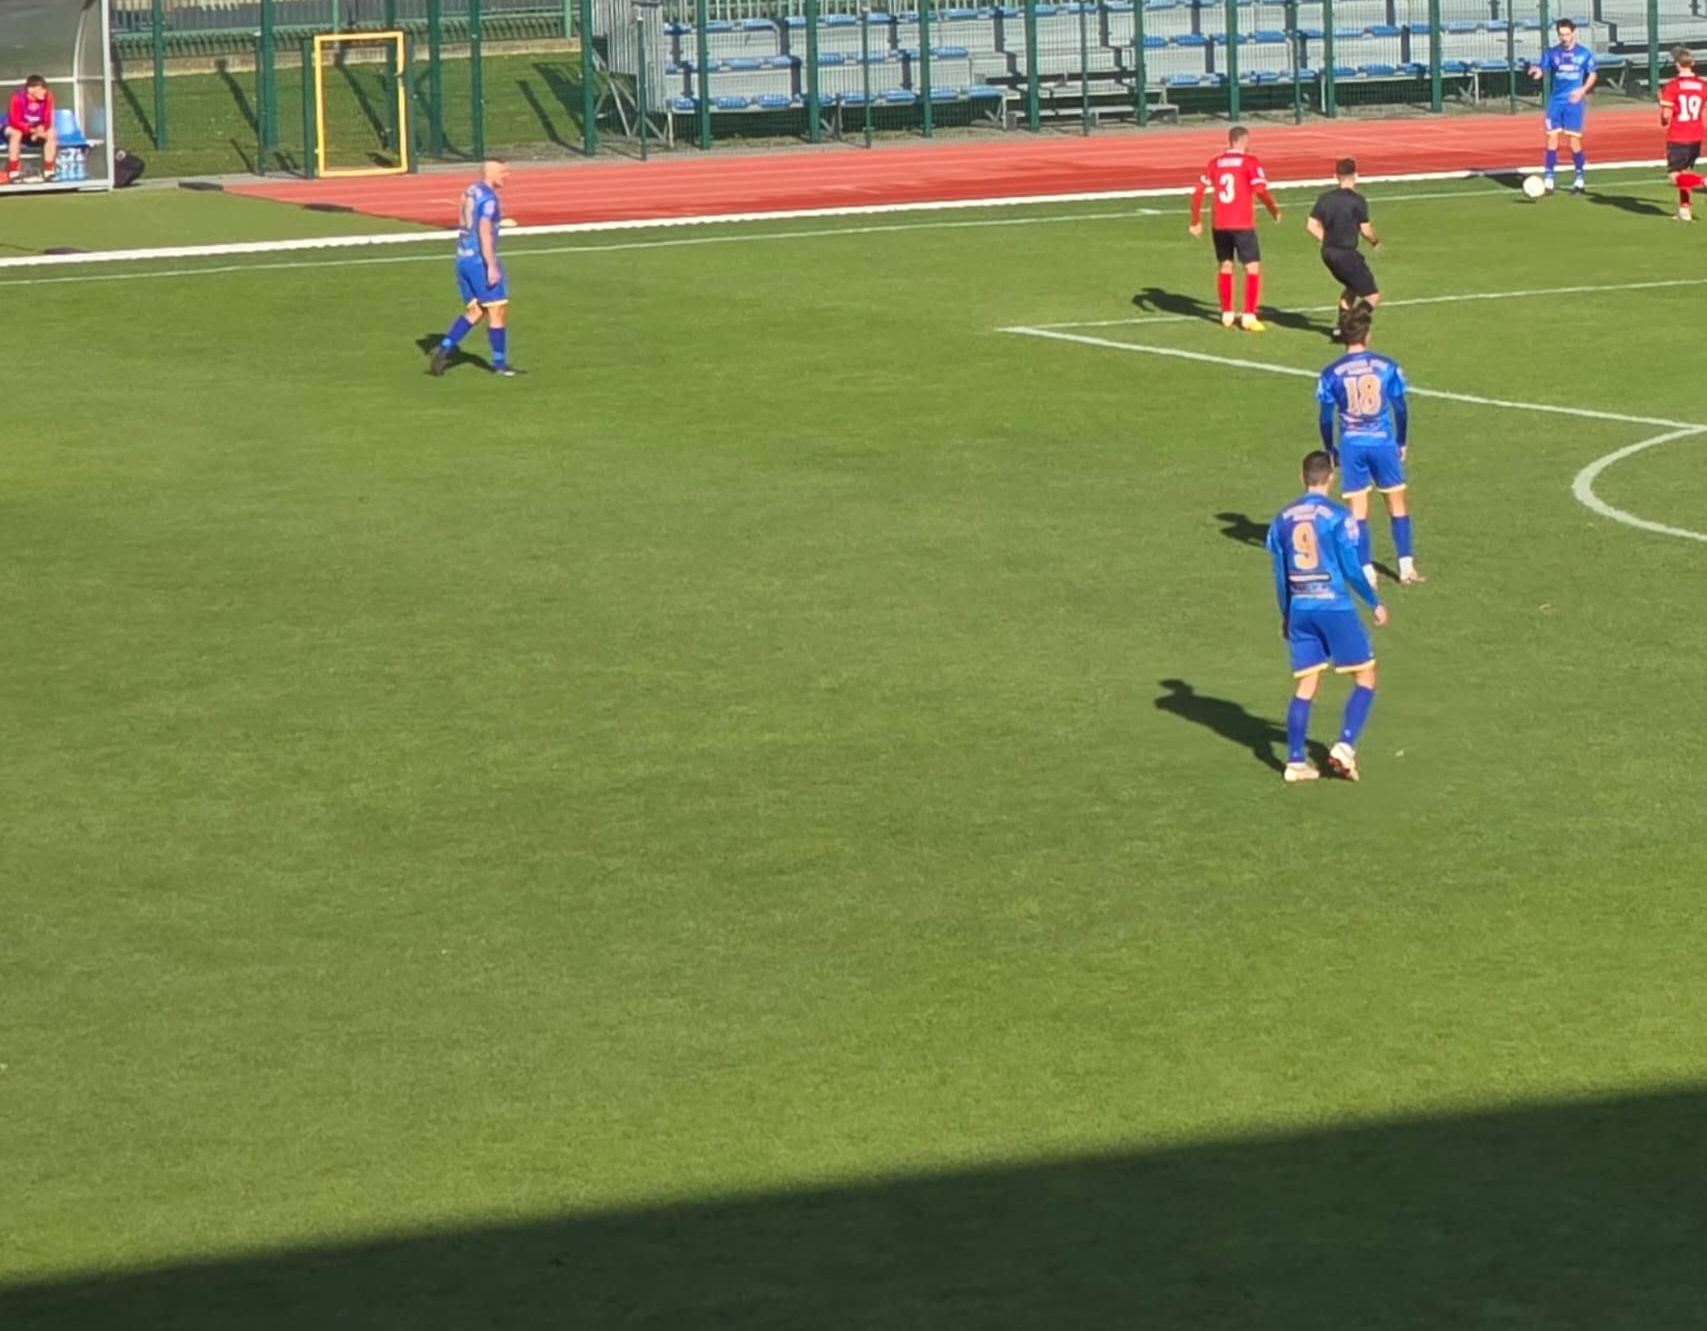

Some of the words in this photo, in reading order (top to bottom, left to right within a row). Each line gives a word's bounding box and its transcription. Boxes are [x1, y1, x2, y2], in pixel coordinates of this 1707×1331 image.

[1677, 94, 1702, 122] 19
[1219, 173, 1236, 204] 3
[1343, 373, 1382, 416] 18
[1292, 520, 1319, 570] 9
